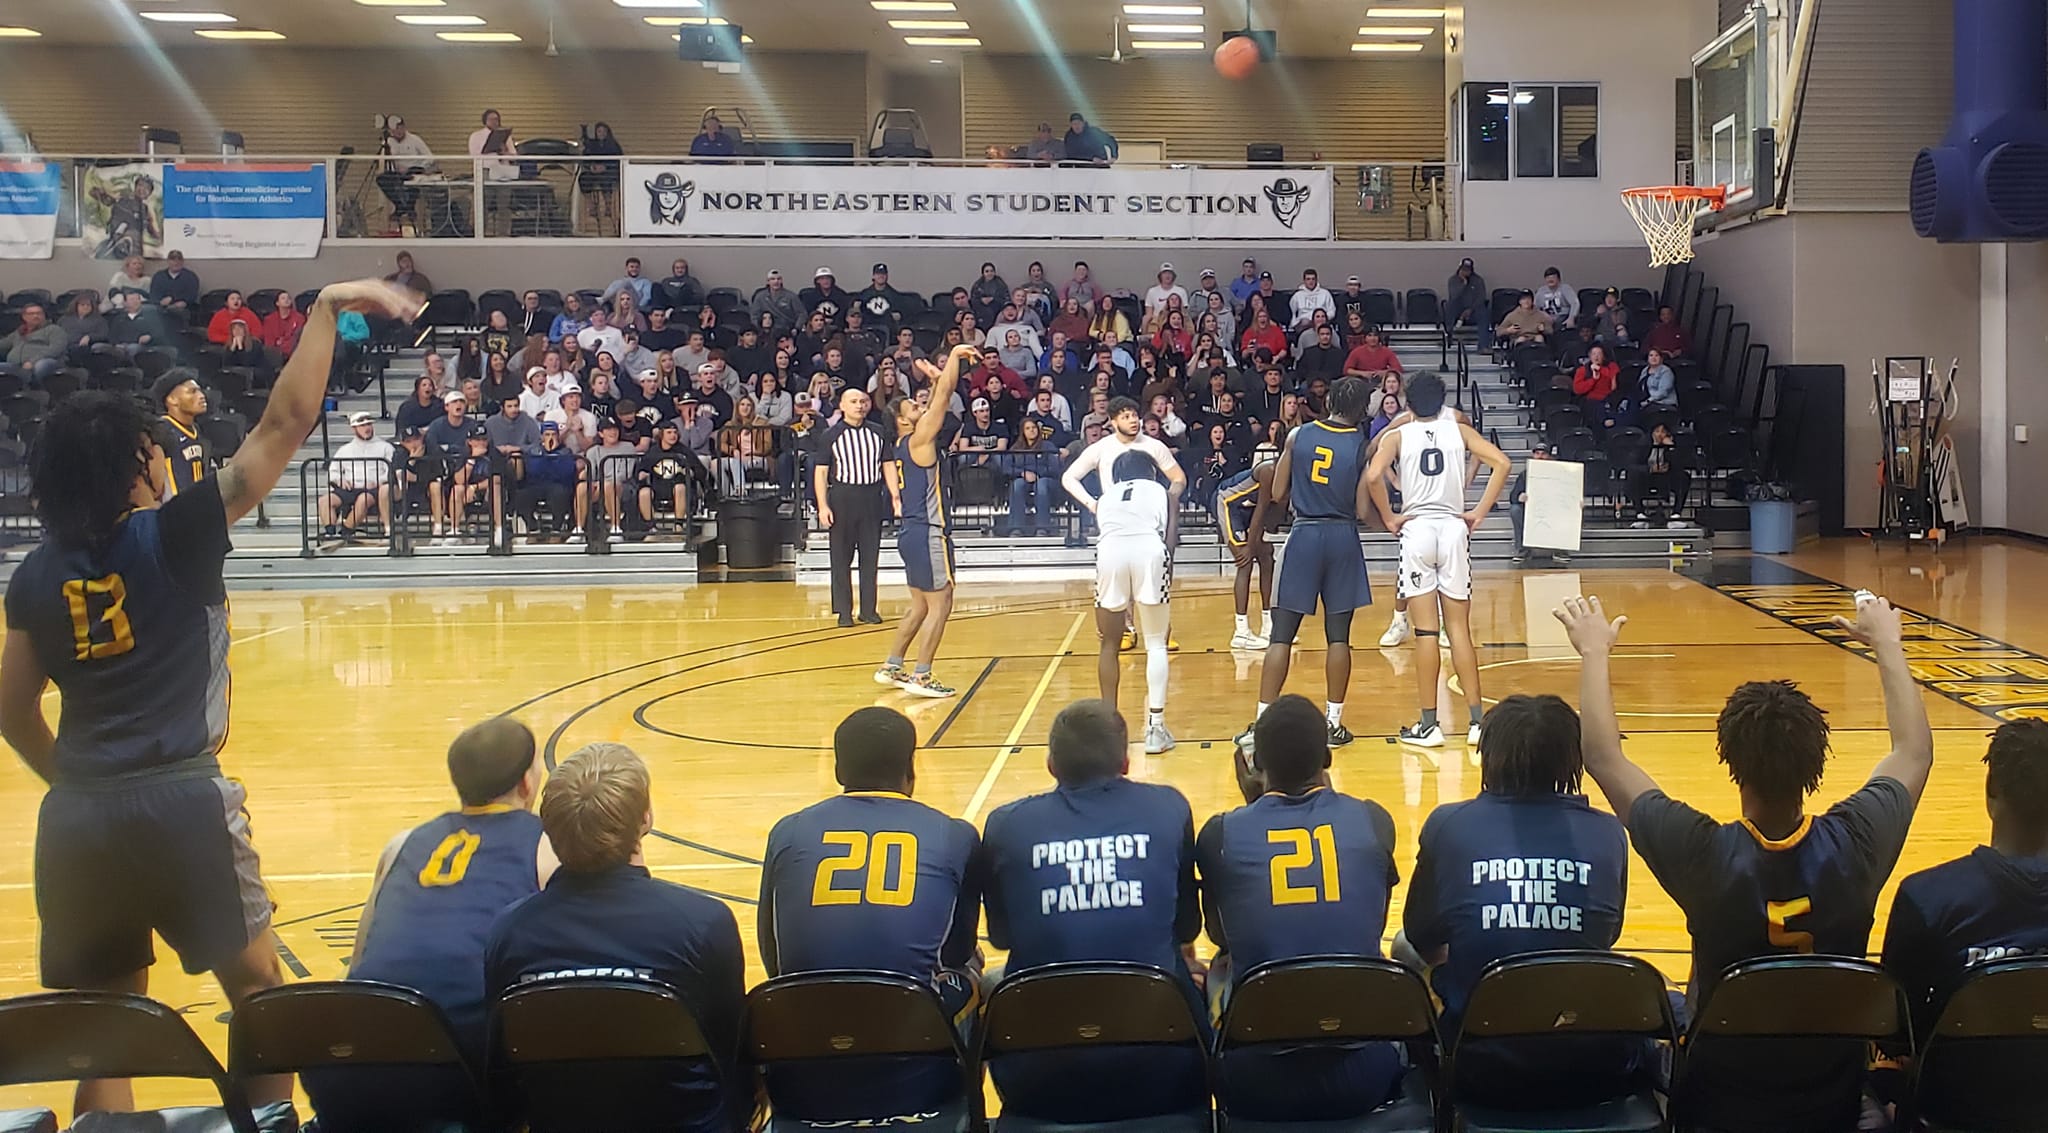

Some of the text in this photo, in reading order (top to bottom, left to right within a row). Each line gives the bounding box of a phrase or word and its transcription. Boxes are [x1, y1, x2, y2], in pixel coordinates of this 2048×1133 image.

[175, 184, 312, 195] The official sports medicine provider
[195, 194, 293, 203] for Northeastern Athletics
[702, 192, 1257, 214] NORTHEASTERN STUDENT SECTION
[823, 306, 831, 314] N
[874, 302, 883, 310] N
[591, 403, 608, 418] N
[664, 465, 673, 474] N
[1311, 445, 1333, 485] 2
[1419, 447, 1444, 476] 0
[62, 573, 135, 661] 13
[419, 829, 481, 887] 0
[1032, 834, 1150, 869] PROTECT
[1267, 824, 1341, 905] 21
[812, 831, 918, 906] 20
[1065, 857, 1117, 885] THE
[1472, 858, 1592, 885] PROTECT
[1041, 880, 1144, 915] PALACE
[1506, 880, 1557, 903] THE
[1482, 904, 1583, 931] PALACE
[1766, 896, 1814, 954] 5
